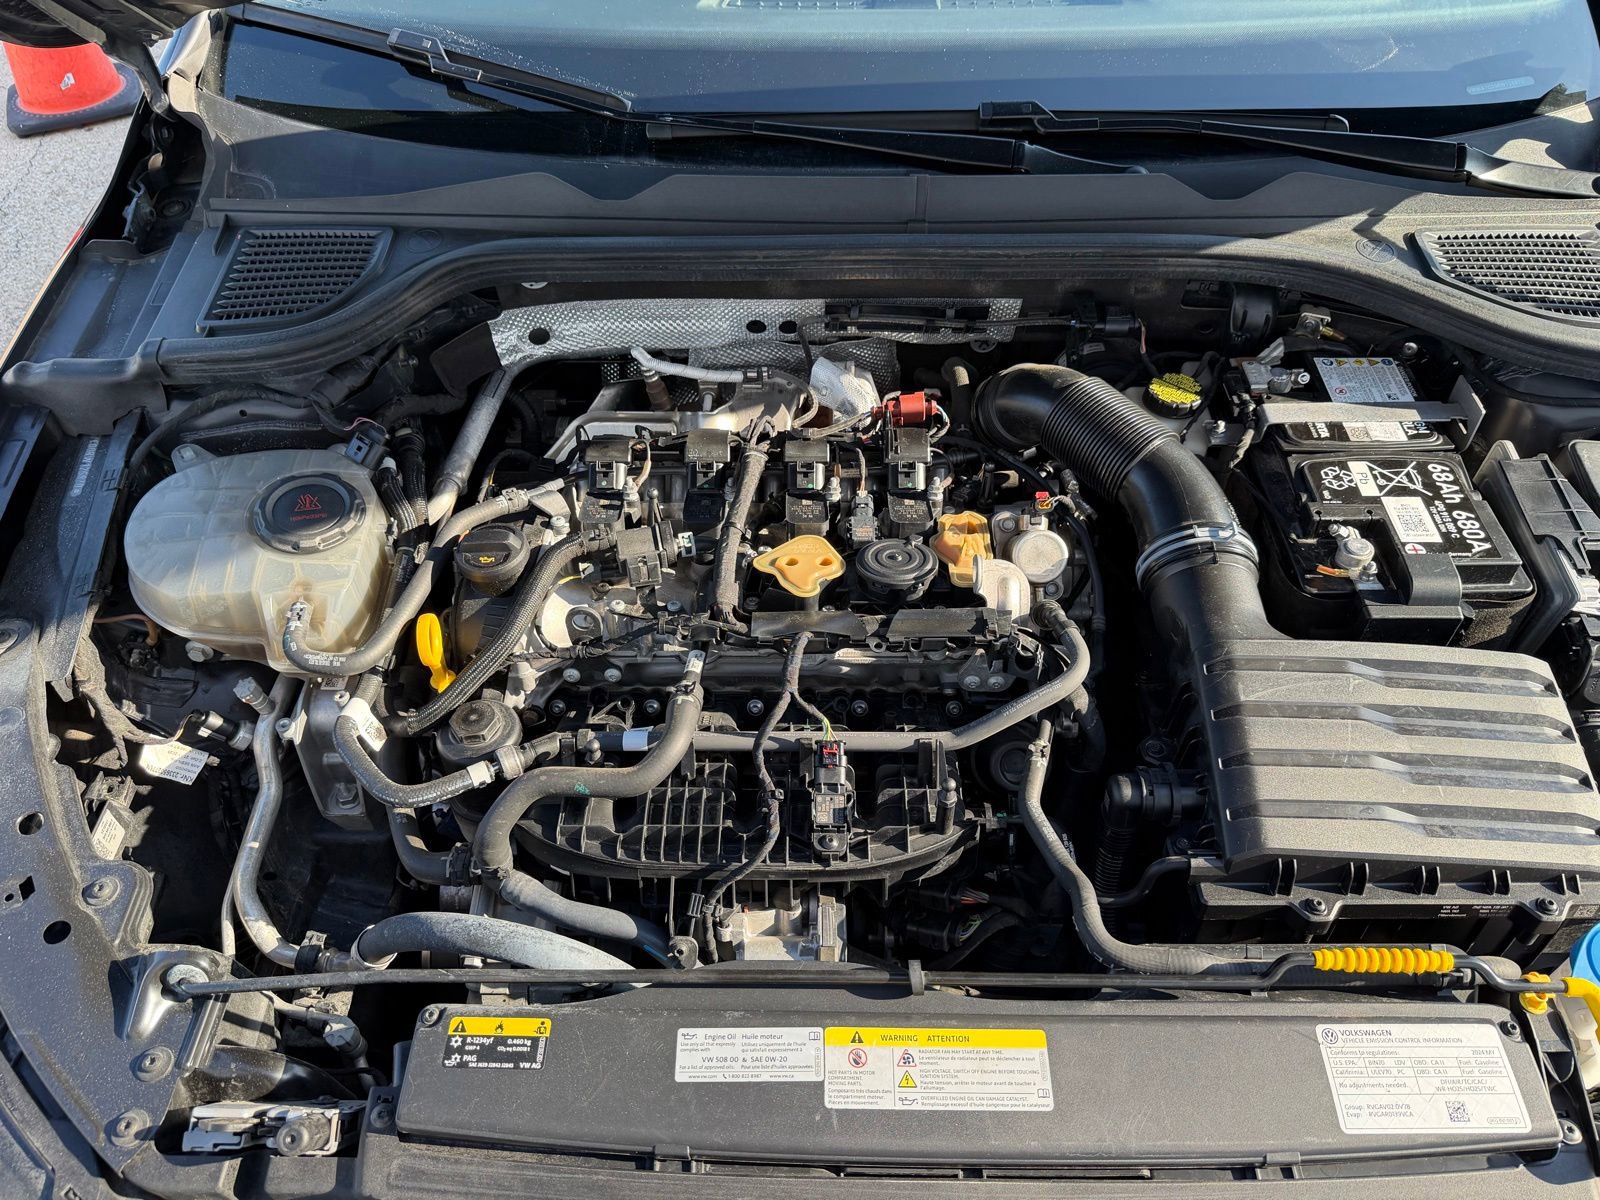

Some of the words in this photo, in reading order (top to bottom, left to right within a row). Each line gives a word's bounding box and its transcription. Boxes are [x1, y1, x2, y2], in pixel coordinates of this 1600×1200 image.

[1315, 422, 1330, 438] RTA
[1415, 422, 1430, 434] GM
[1356, 472, 1368, 484] Pb
[1428, 463, 1464, 504] 68Ah
[1452, 510, 1492, 553] 680A
[466, 1037, 494, 1045] R-1234yf
[704, 1033, 726, 1041] Engine
